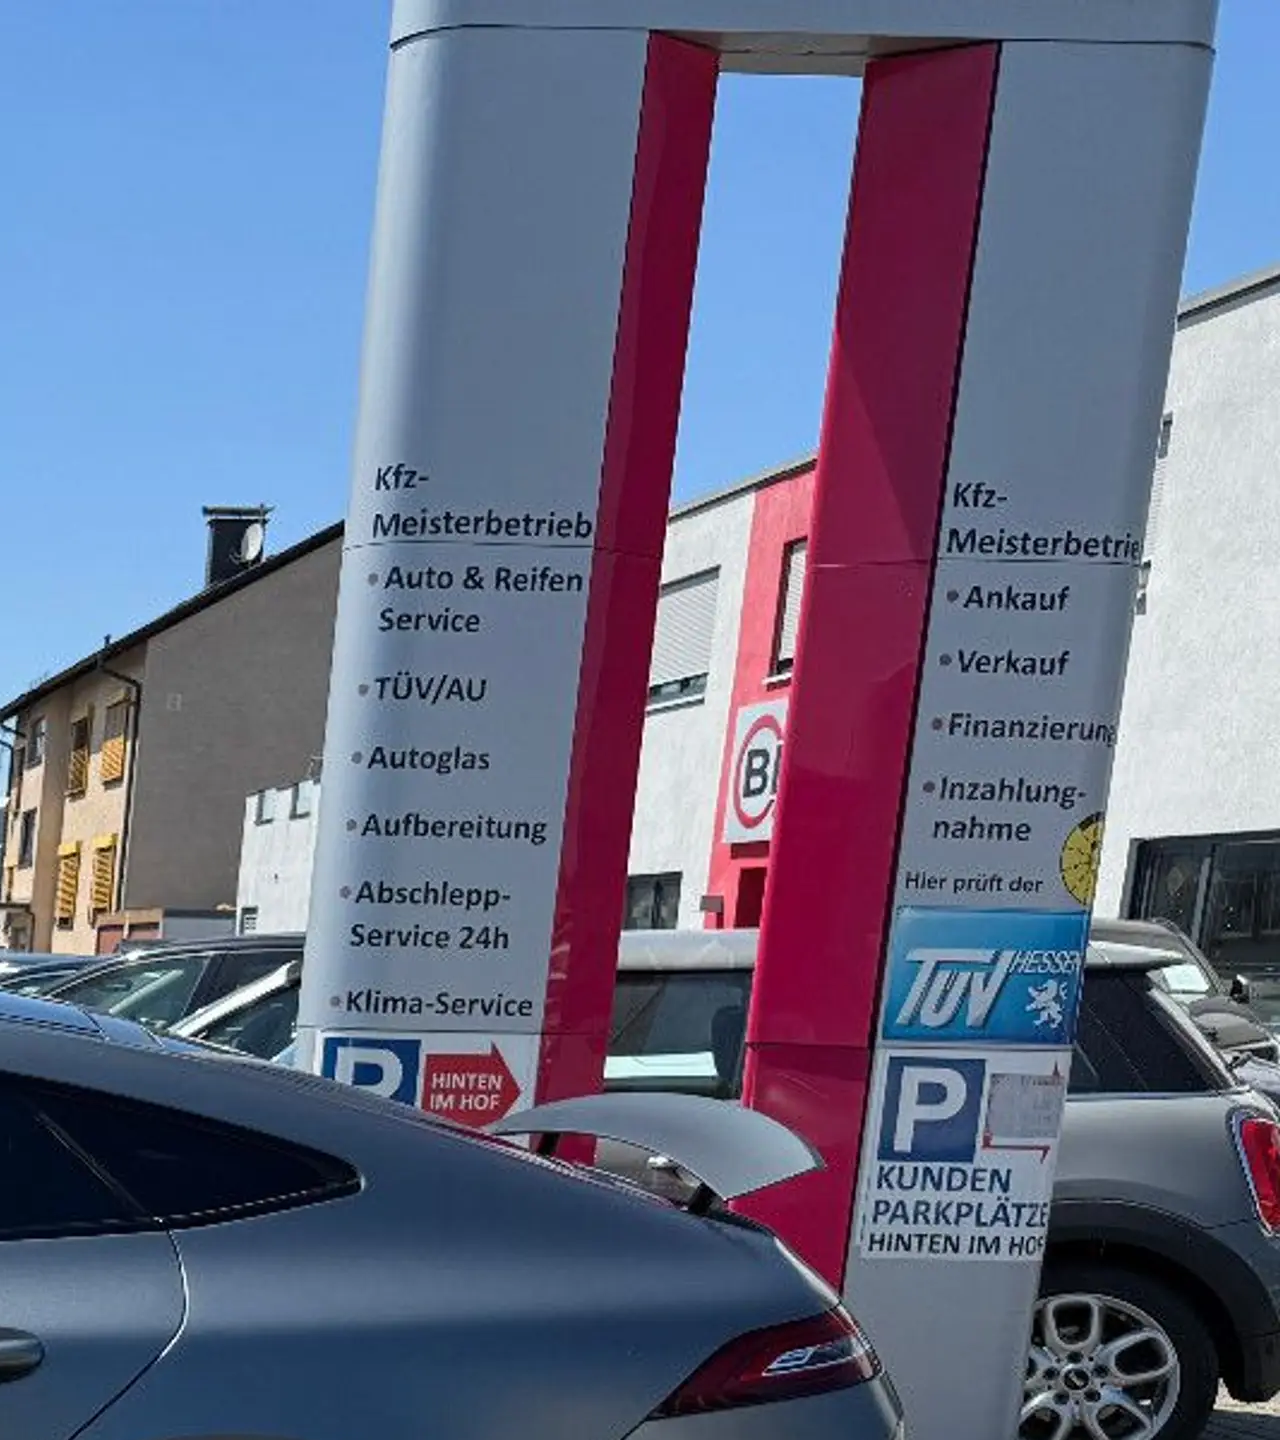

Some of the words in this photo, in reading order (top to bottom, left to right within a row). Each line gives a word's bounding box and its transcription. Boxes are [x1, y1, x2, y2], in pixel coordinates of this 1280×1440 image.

[375, 463, 430, 491] Kfz-
[952, 481, 1009, 509] Kfz-
[372, 509, 593, 539] Meisterbetrieb
[946, 528, 1144, 560] Meisterbetrie
[383, 565, 453, 590] Auto
[462, 566, 484, 590] &
[494, 566, 583, 593] Reifen
[963, 584, 1070, 612] Ankauf
[378, 607, 481, 633] Service
[958, 649, 1070, 677] Verkauf
[373, 671, 488, 705] TÜV/AU
[367, 746, 490, 774] Autoglas
[939, 777, 1087, 810] Inzahlung-
[361, 812, 548, 846] Aufbereitung
[933, 816, 1032, 842] nahme
[355, 880, 512, 910] Abschlepp-
[905, 871, 947, 891] Hier
[953, 870, 1003, 894] prüft
[1009, 874, 1044, 893] der
[349, 924, 450, 949] Service
[458, 926, 510, 949] 24h
[895, 948, 1018, 1028] TÜV
[345, 990, 533, 1017] Klima-Service
[431, 1072, 504, 1091] HINTEN
[430, 1093, 457, 1111] IM
[460, 1093, 501, 1111] HOF
[892, 1065, 967, 1153] P
[876, 1164, 1011, 1193] KUNDEN
[868, 1233, 961, 1254] HINTEN
[968, 1234, 1001, 1255] IM
